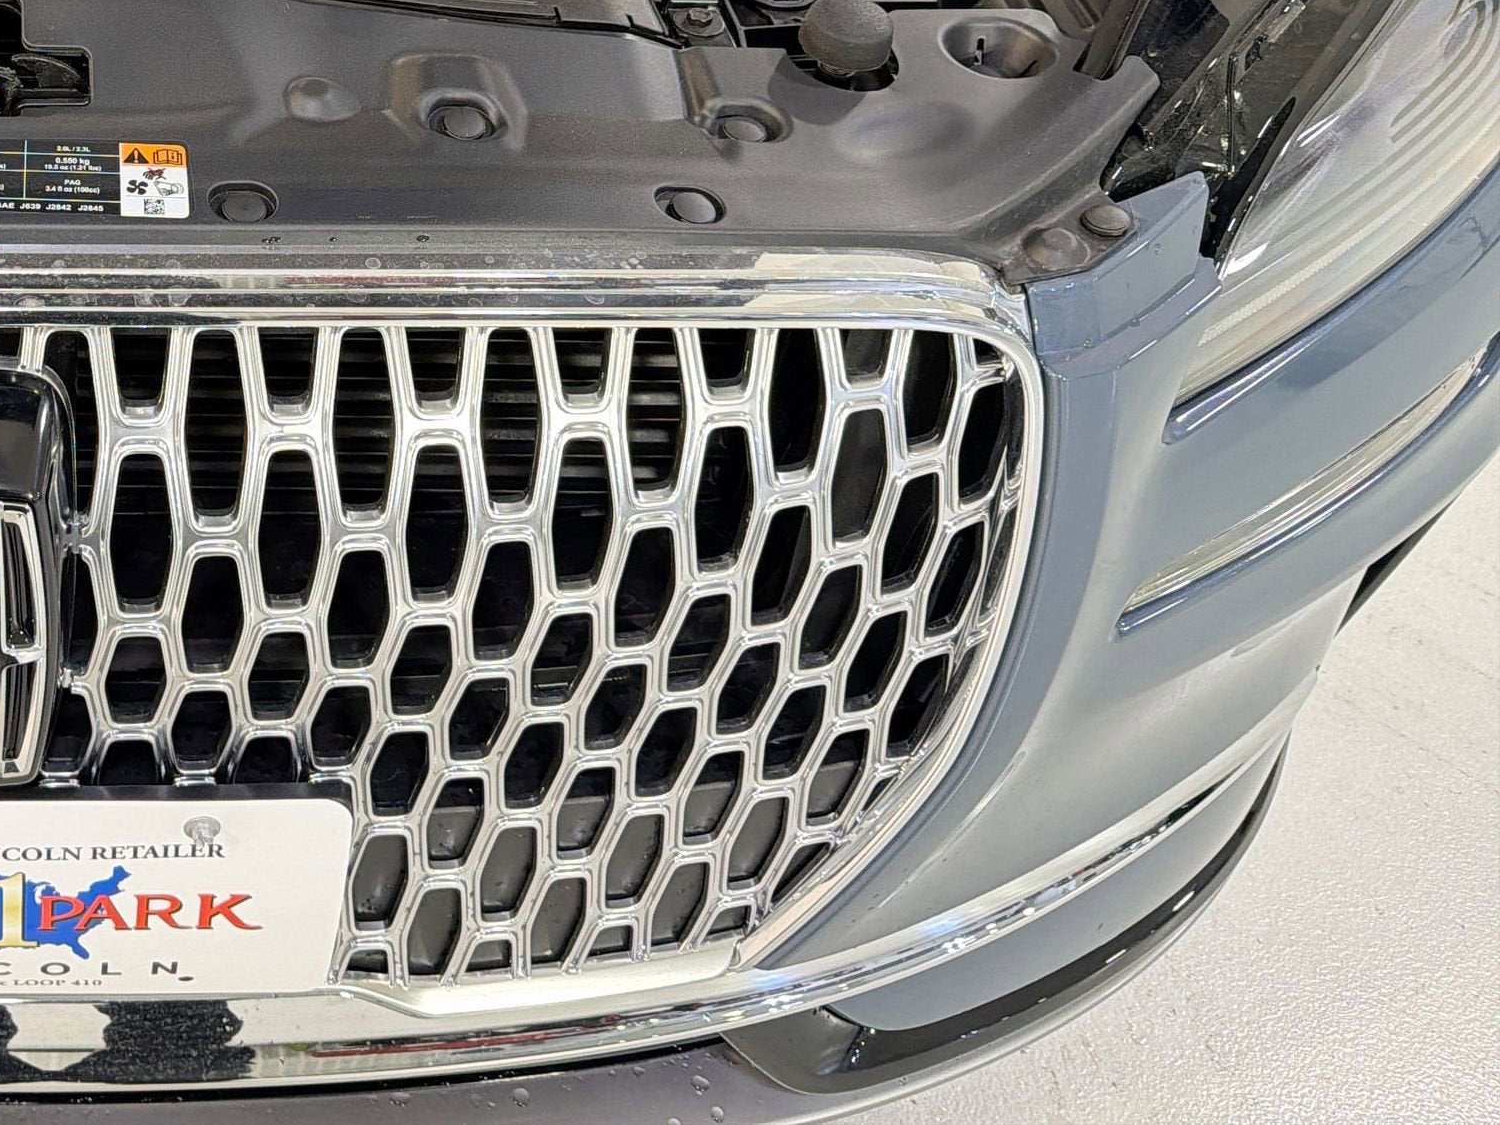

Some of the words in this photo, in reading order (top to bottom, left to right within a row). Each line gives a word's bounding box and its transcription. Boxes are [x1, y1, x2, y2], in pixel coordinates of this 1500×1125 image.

[79, 158, 90, 166] kg
[73, 186, 100, 195] (100cc)
[19, 202, 41, 210] J639
[45, 203, 72, 211] J2842
[90, 843, 226, 860] RETAILER
[37, 893, 264, 932] PARK
[13, 979, 65, 987] LOOP
[71, 979, 102, 987] 410
